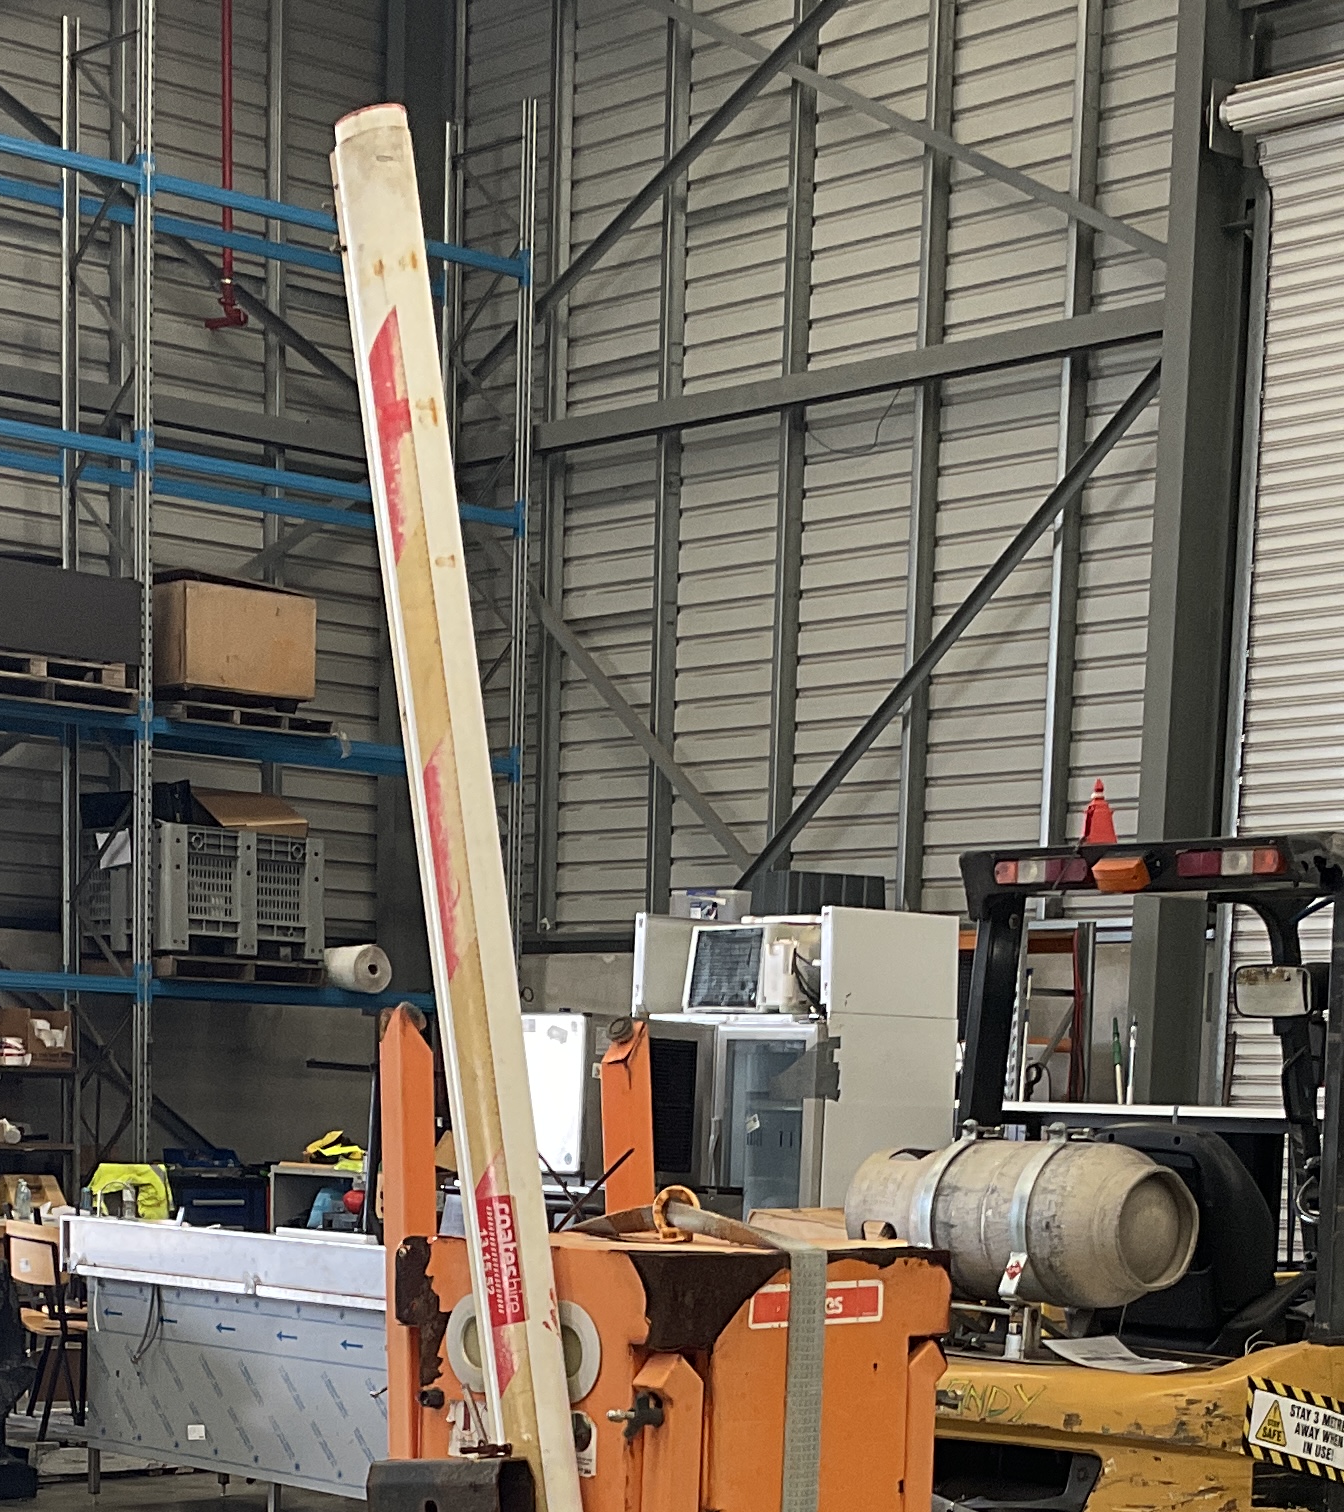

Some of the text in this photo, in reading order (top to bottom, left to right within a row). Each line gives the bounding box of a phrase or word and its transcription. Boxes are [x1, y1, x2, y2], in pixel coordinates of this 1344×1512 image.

[482, 1253, 493, 1272] 15
[1290, 1404, 1312, 1421] STAY
[1313, 1411, 1320, 1424] 3
[1262, 1426, 1282, 1442] SAFE
[1294, 1422, 1344, 1448] AWAY WHEN
[1302, 1441, 1313, 1456] IN
